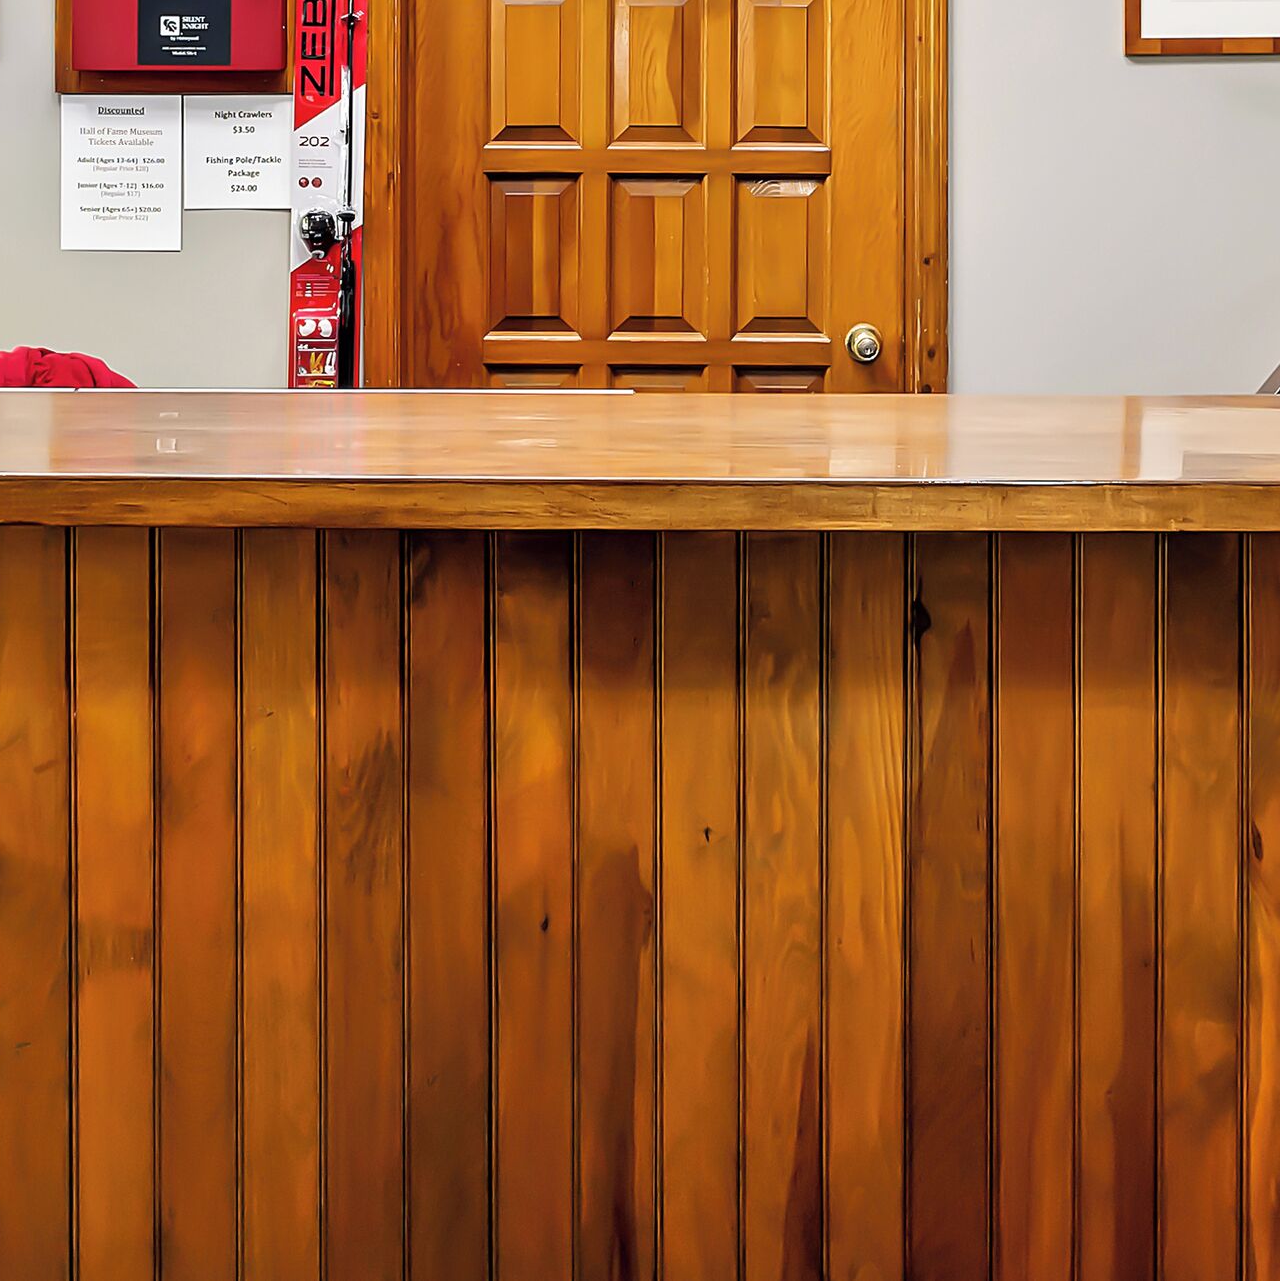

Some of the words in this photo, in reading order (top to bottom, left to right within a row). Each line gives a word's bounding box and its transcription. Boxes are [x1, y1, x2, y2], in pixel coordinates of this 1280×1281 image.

[98, 106, 145, 115] Discounted
[214, 111, 236, 119] Night
[238, 111, 272, 119] Crawlers
[80, 127, 95, 135] Hall
[97, 127, 105, 135] of
[107, 127, 128, 135] Fame
[232, 126, 255, 134] $3.50
[118, 138, 154, 146] Available
[299, 136, 330, 147] 202
[206, 156, 234, 165] Fishing
[236, 156, 282, 164] Pole/Tackle
[228, 170, 260, 178] Package
